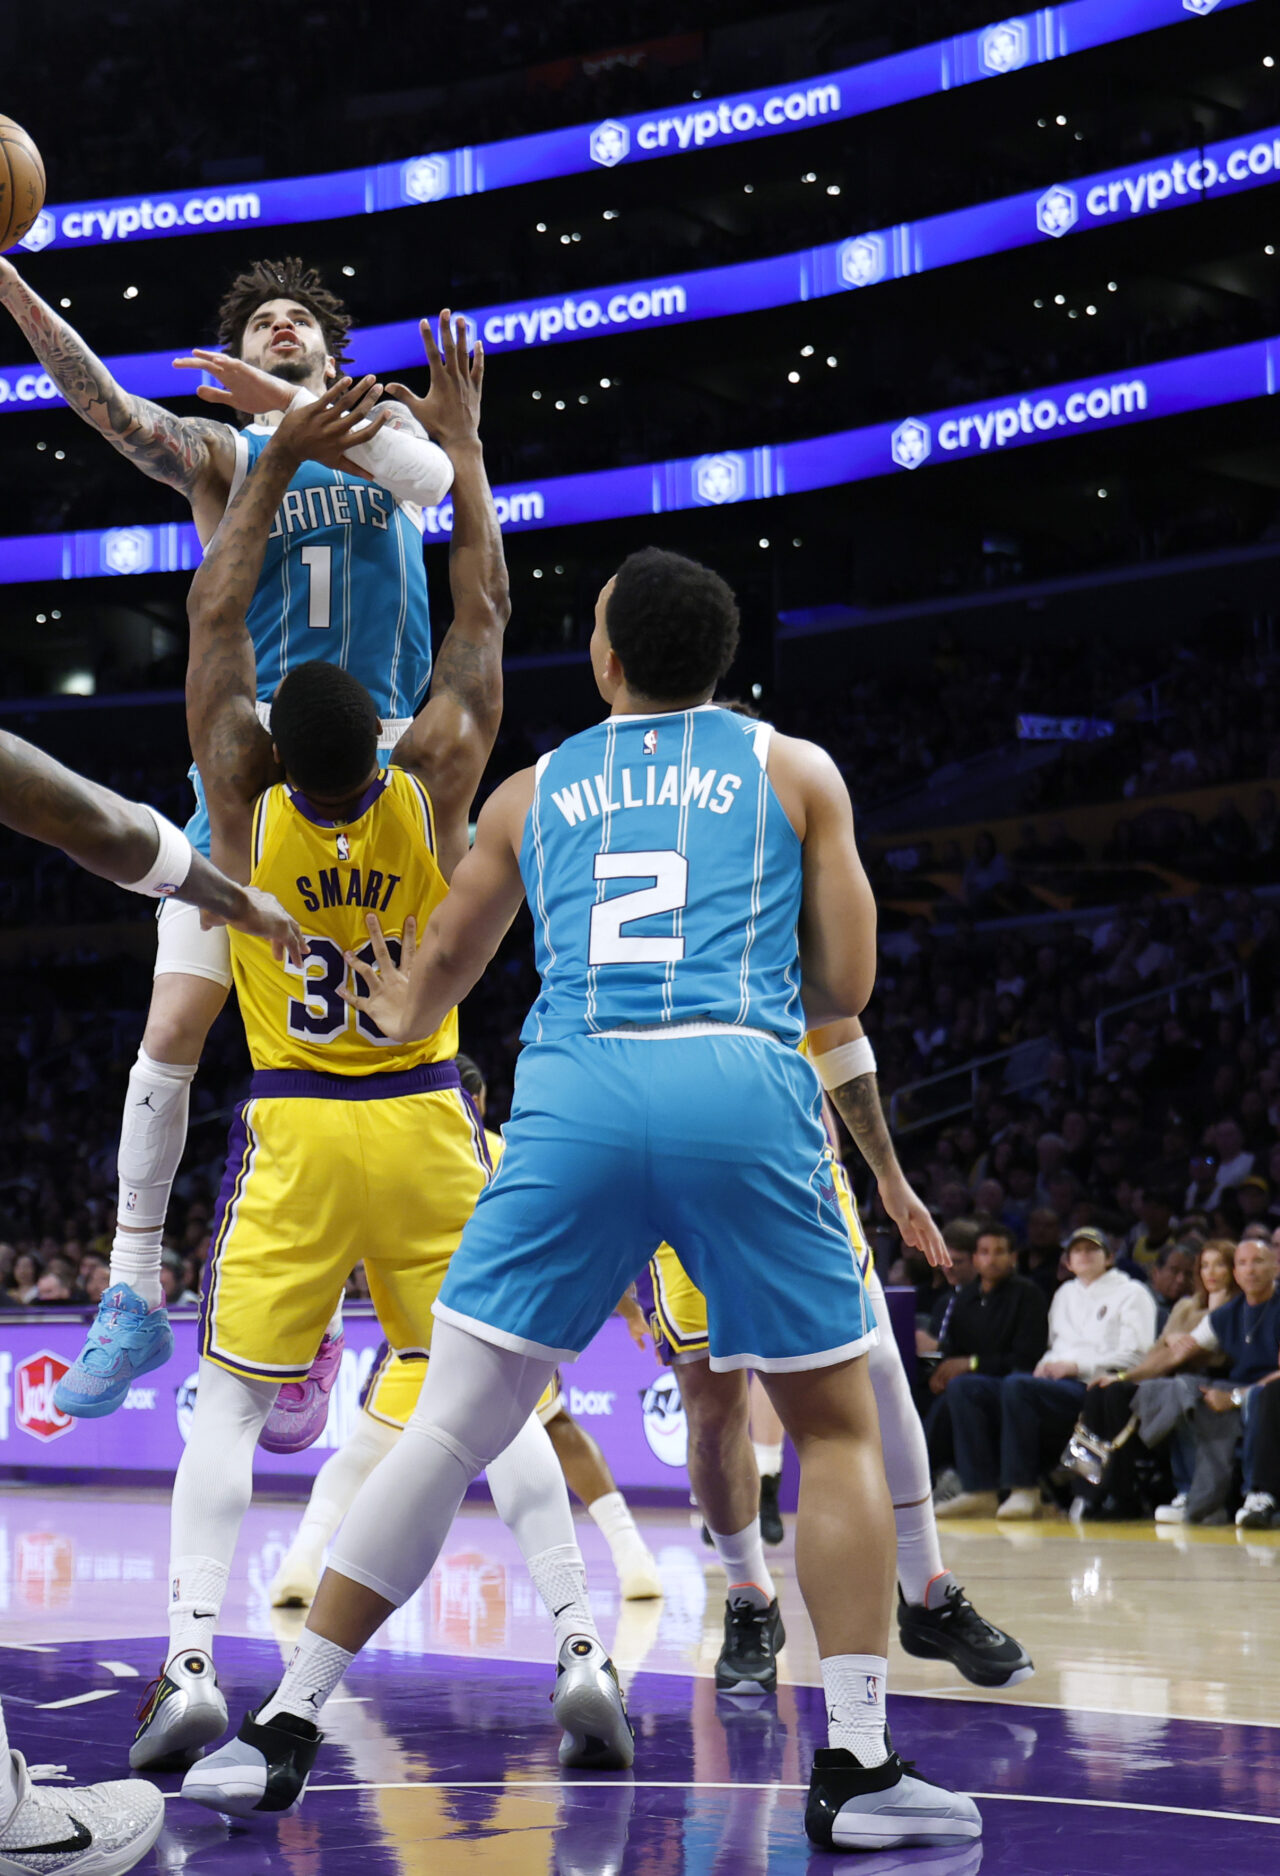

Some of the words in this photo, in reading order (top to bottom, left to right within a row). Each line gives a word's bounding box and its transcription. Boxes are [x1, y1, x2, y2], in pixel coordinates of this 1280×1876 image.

[636, 84, 840, 149] crypto.com
[1086, 138, 1280, 216] crypto.co
[61, 192, 260, 240] crypto.com
[484, 285, 686, 345] crypto.com
[938, 380, 1146, 449] crypto.com
[269, 485, 389, 539] RNETS
[301, 545, 331, 629] 1
[550, 765, 742, 828] WILLIAMS
[296, 867, 401, 912] SMART
[588, 849, 688, 966] 2
[569, 1386, 615, 1415] box
